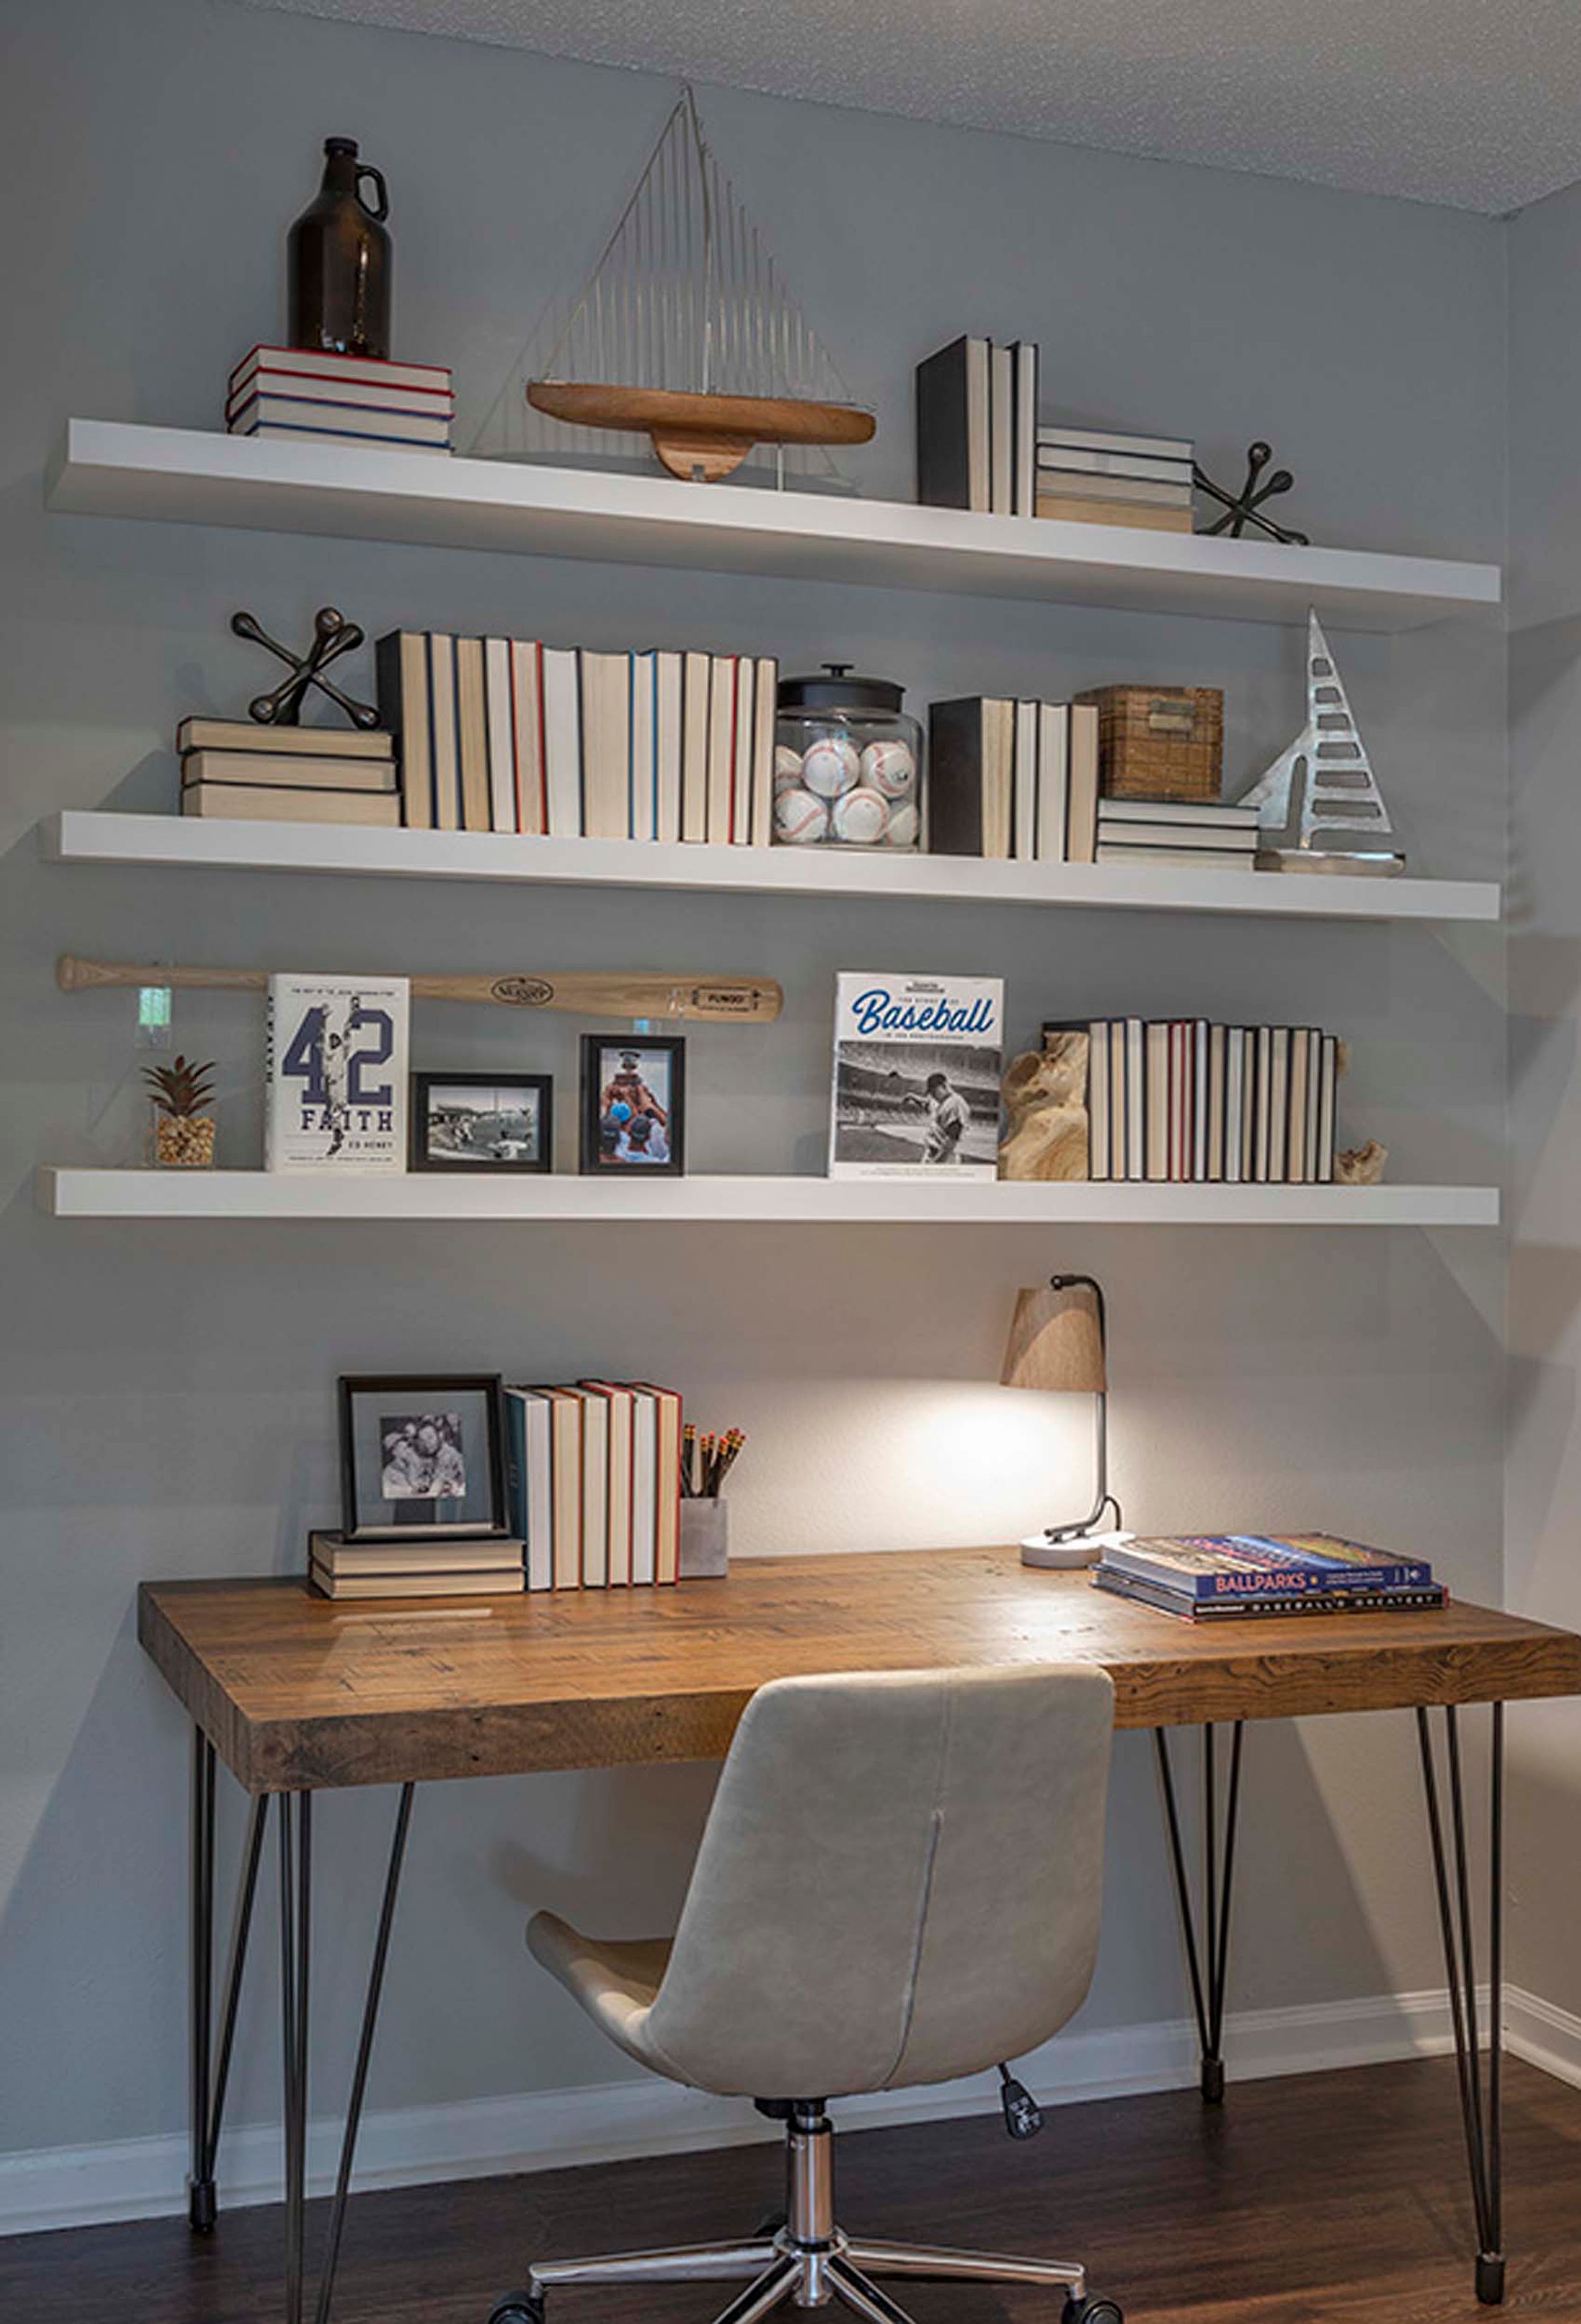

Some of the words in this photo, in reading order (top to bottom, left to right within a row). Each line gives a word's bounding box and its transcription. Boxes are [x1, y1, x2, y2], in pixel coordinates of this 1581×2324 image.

[852, 989, 995, 1035] Baseball
[282, 1006, 393, 1105] 42
[301, 1110, 393, 1132] FAITH
[1215, 1572, 1307, 1593] BALLPARKS
